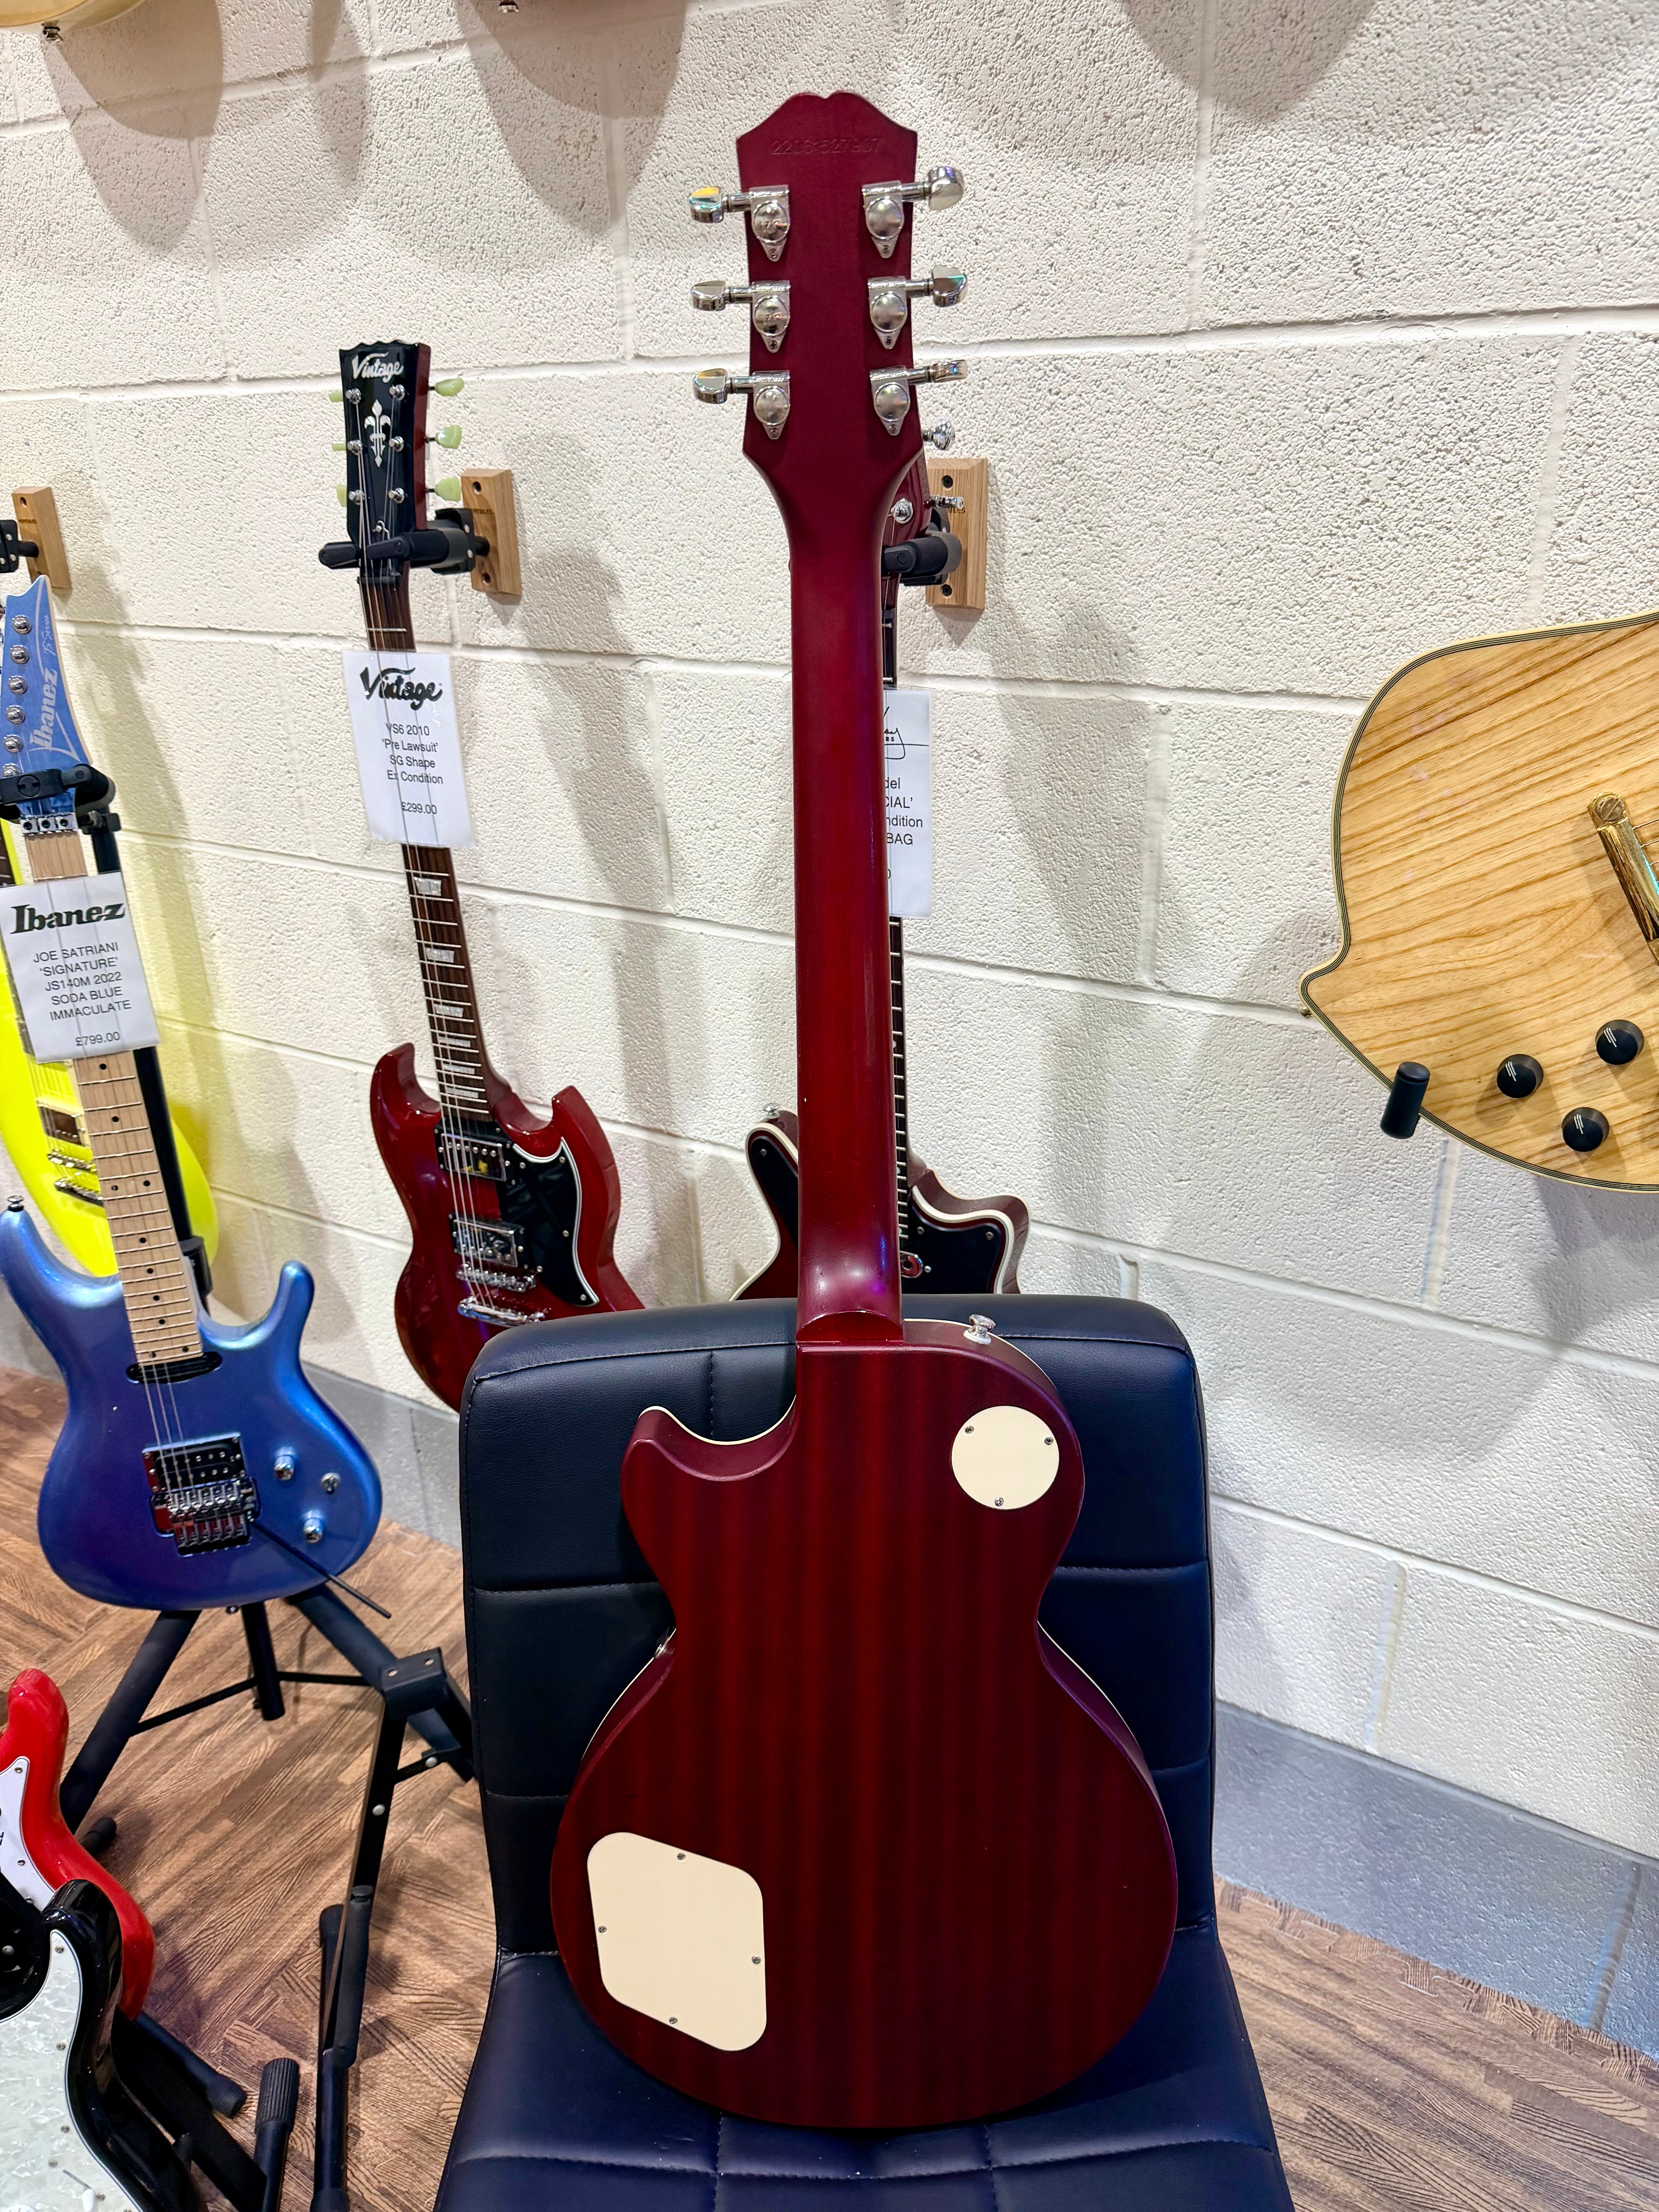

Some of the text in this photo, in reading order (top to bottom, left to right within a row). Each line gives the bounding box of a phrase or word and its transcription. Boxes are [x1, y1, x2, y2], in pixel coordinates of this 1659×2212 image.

[352, 352, 404, 383] Vintage
[361, 667, 443, 711] Vintage
[30, 668, 57, 750] Ibanez
[386, 723, 430, 736] VS6 2010
[390, 755, 435, 770] SG Shape
[387, 770, 443, 784] Ex Condition
[884, 777, 900, 789] del
[402, 802, 437, 814] £299.00
[886, 814, 922, 827] ndition
[10, 903, 126, 934] Ibanez
[33, 942, 118, 963] JOE SATRIANI
[45, 971, 122, 991] JS140M 2022
[52, 986, 123, 1005] SODA BLUE
[50, 1000, 131, 1021] IMMACULATE
[75, 1032, 120, 1046] £799.00
